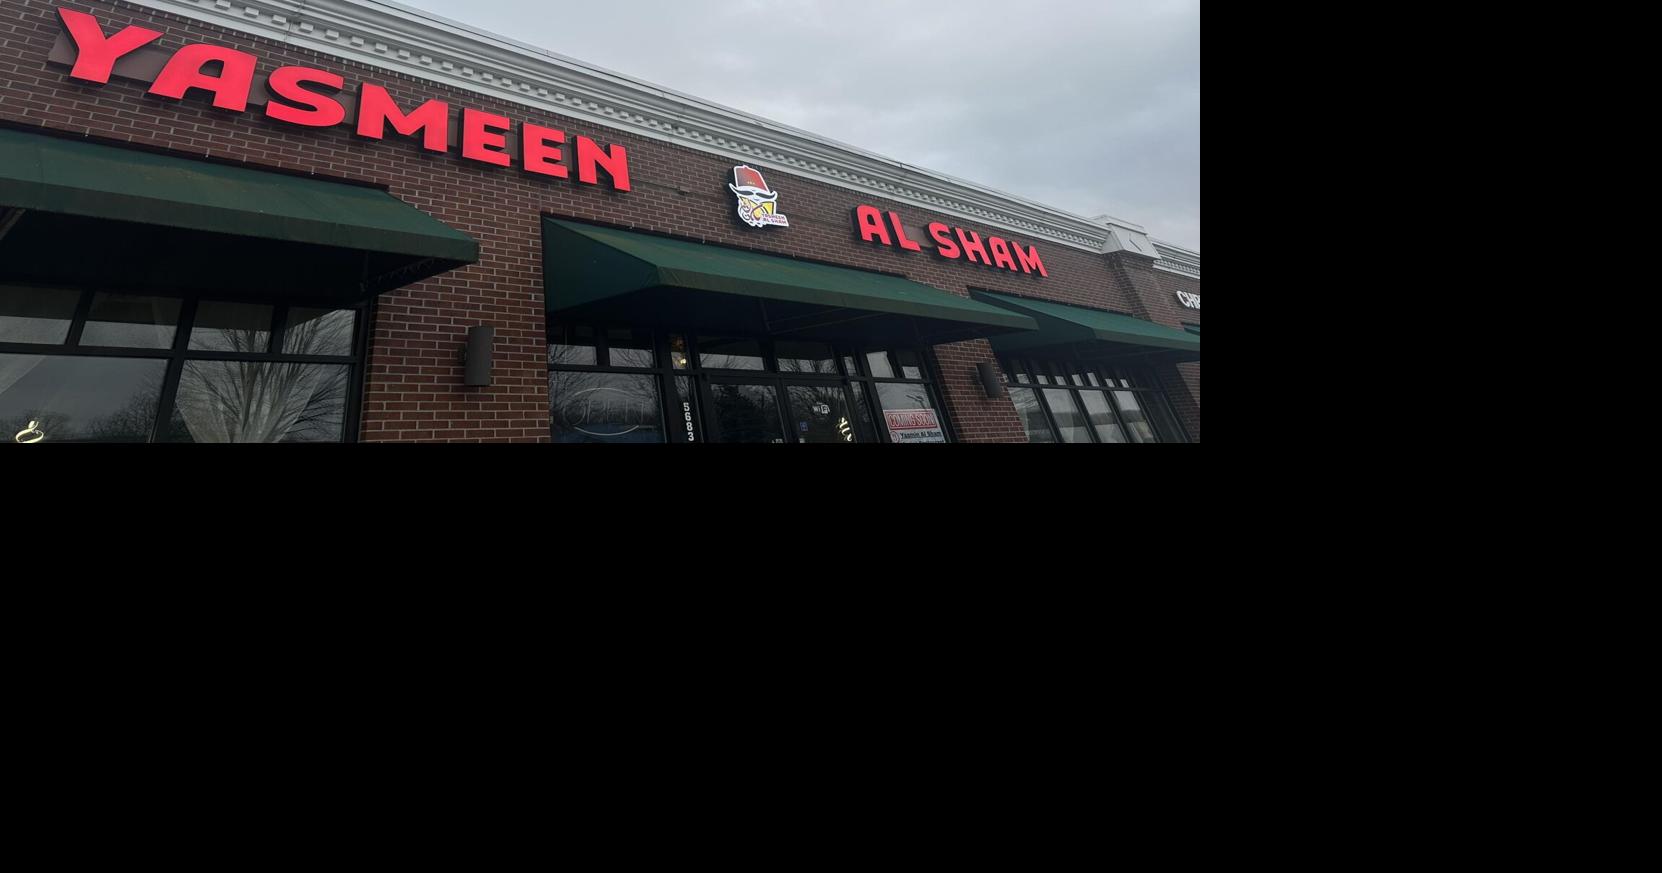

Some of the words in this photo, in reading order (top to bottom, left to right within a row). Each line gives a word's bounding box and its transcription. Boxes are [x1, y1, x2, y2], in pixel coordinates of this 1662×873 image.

[56, 7, 631, 192] YASMEEN
[856, 203, 921, 252] AL
[927, 221, 1049, 278] SHAM
[683, 402, 695, 442] 5683
[889, 413, 917, 427] COMING
[915, 412, 936, 426] SOON
